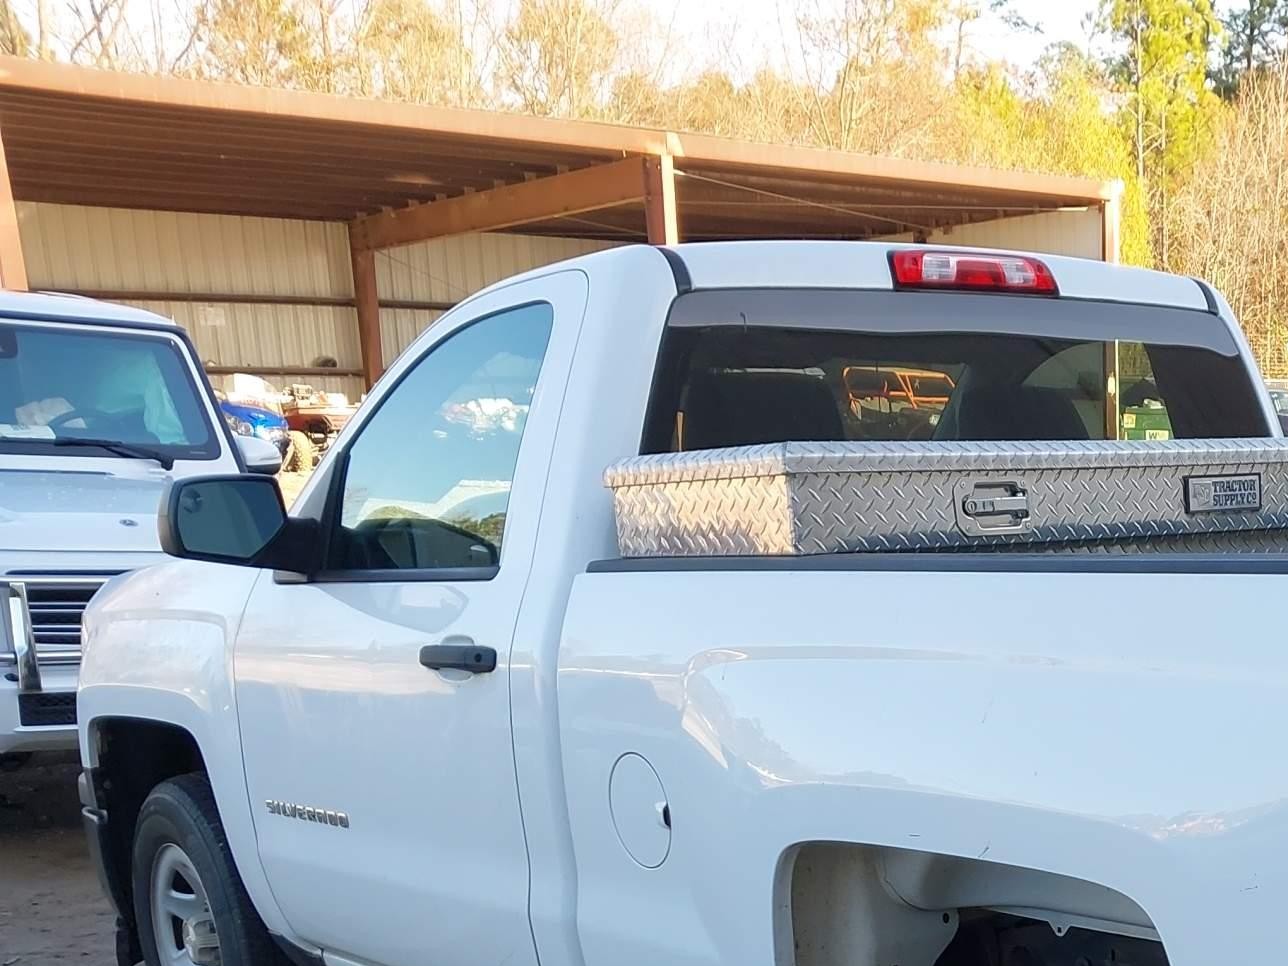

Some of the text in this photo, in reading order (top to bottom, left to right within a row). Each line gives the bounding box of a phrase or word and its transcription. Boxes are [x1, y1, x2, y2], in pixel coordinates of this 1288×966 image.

[1211, 479, 1257, 493] TRACTOR
[1212, 493, 1246, 507] SUPPLY
[265, 799, 350, 828] SILVERADO
